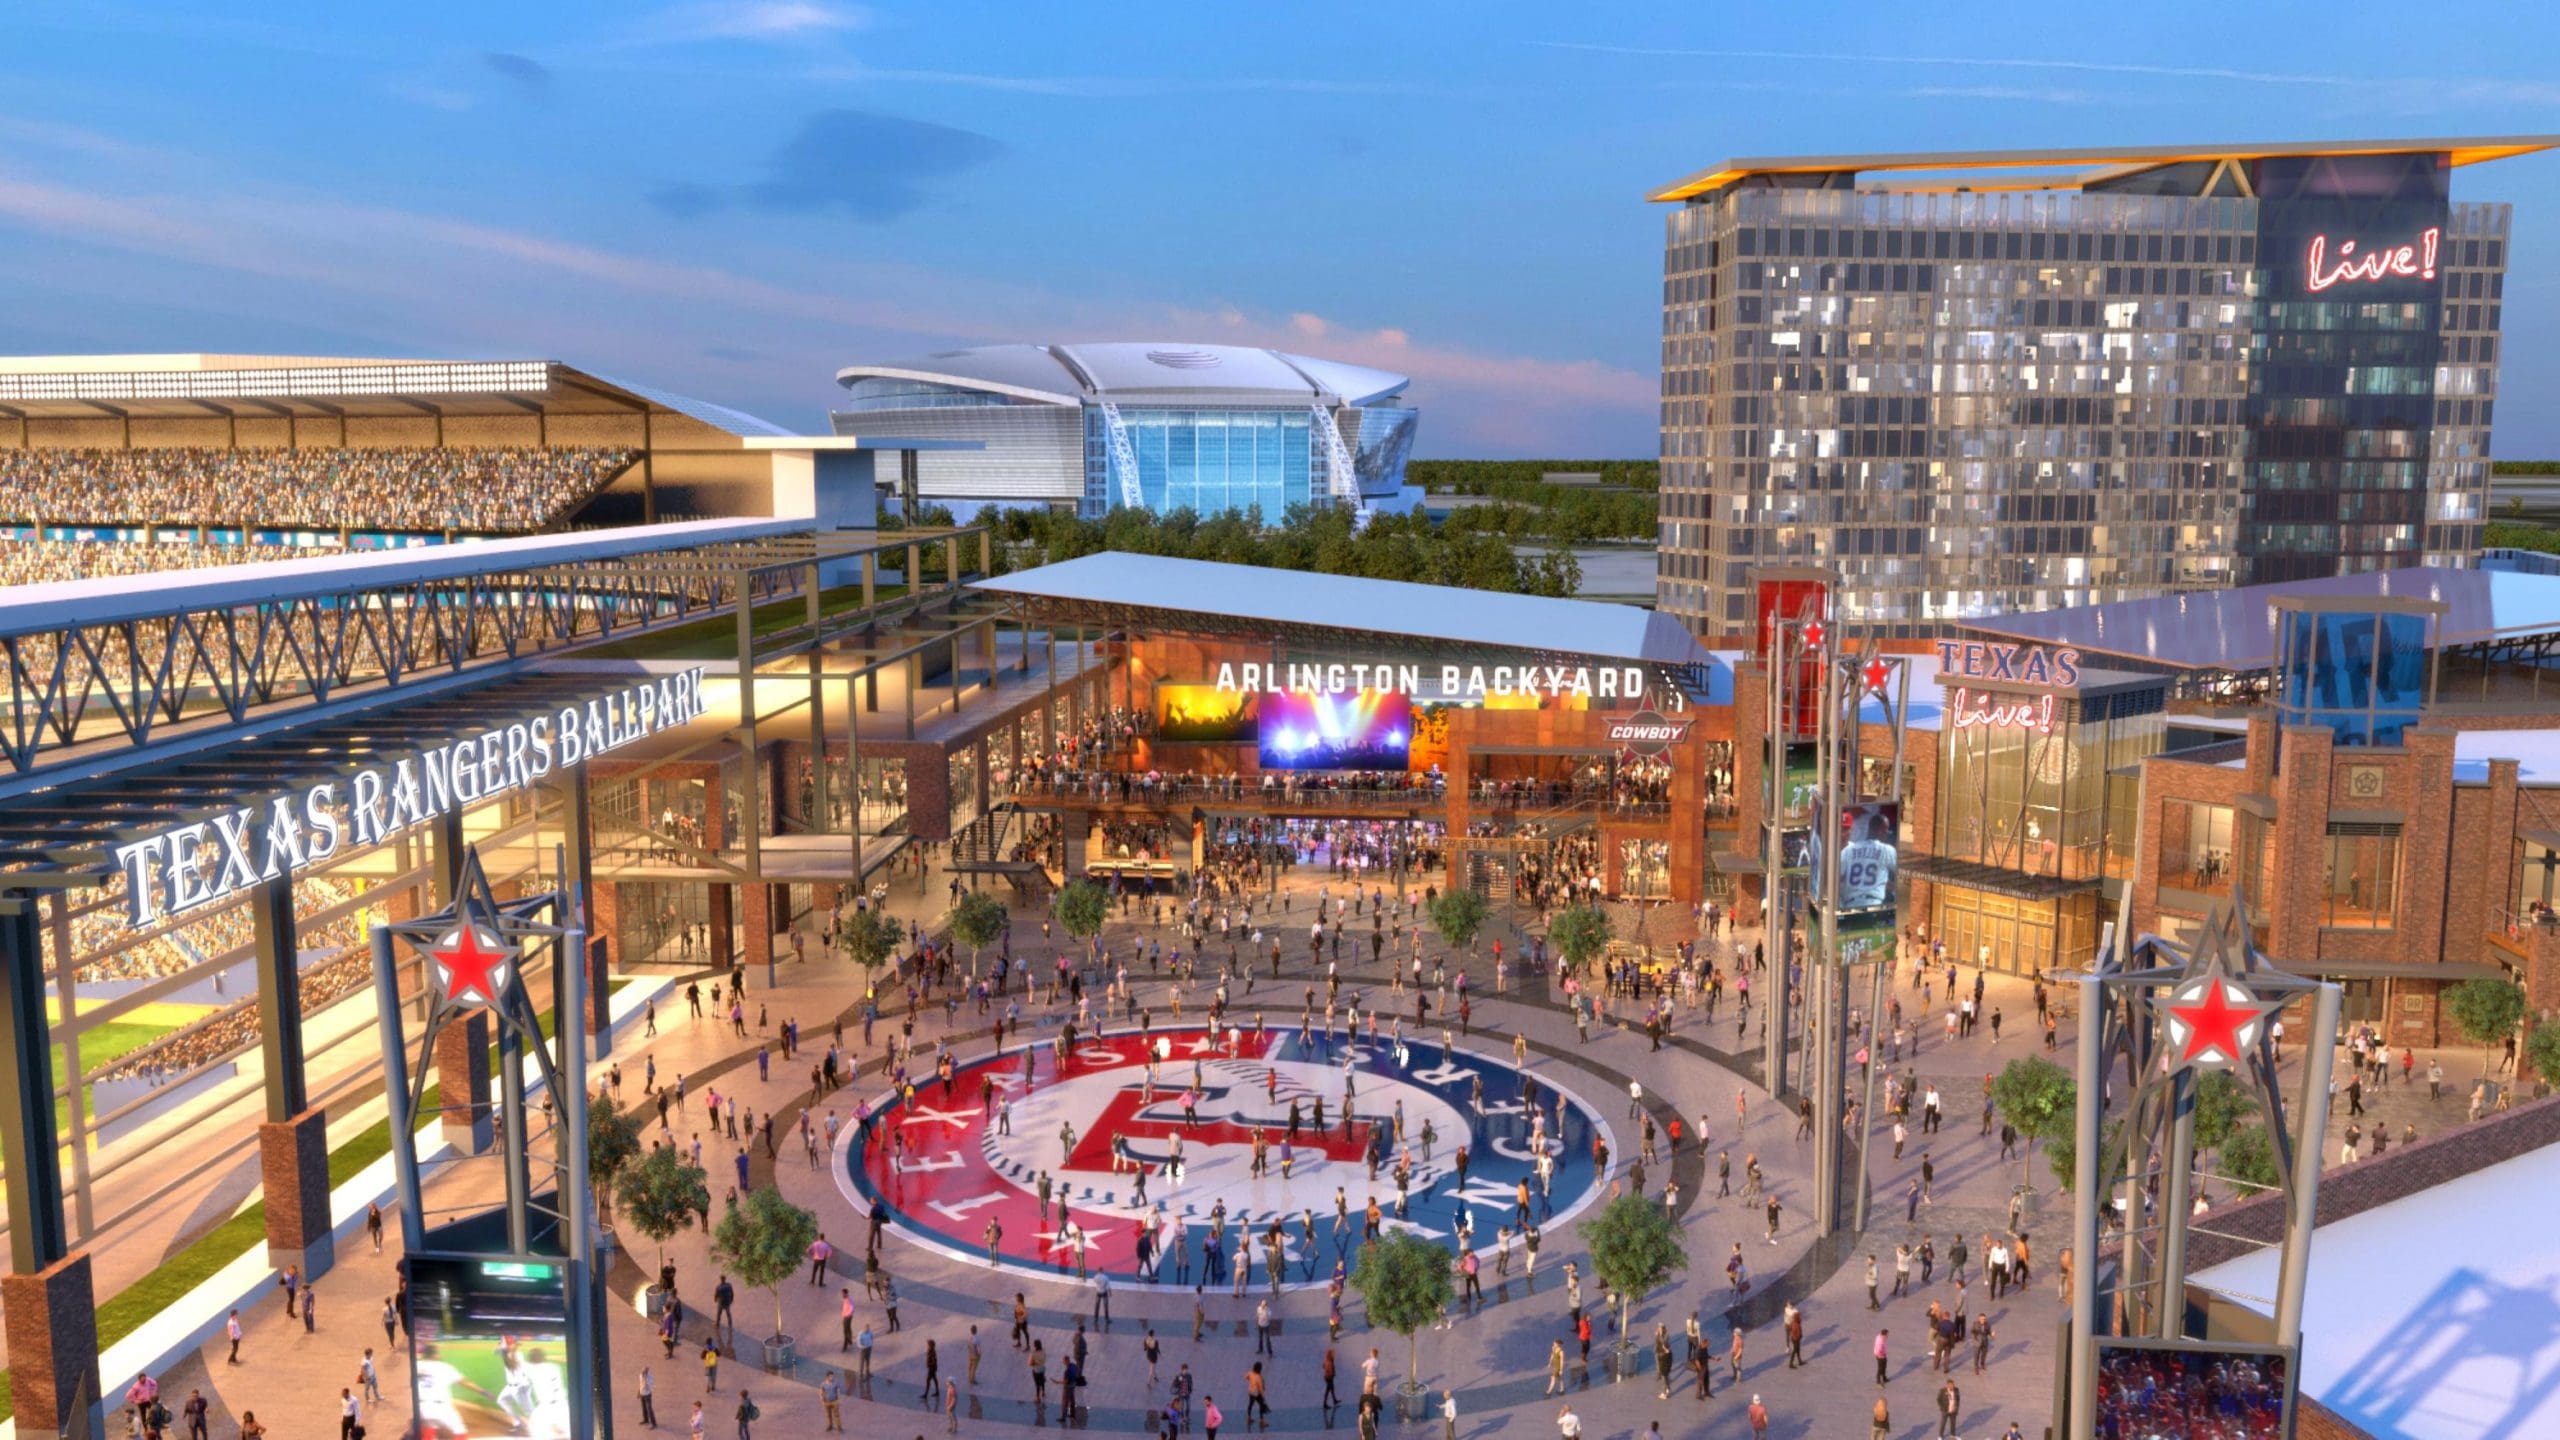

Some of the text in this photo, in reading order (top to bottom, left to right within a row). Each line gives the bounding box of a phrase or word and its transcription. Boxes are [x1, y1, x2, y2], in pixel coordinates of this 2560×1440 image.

[2309, 227, 2439, 292] Live!
[1216, 662, 1419, 695] ARLINGTON
[1442, 665, 1644, 698] BACKYARD
[1936, 639, 2080, 688] TEXAS
[1611, 726, 1682, 740] COWBOY
[1954, 688, 2054, 733] Live!
[115, 667, 708, 929] TEXAS RANGERS BALLPARK
